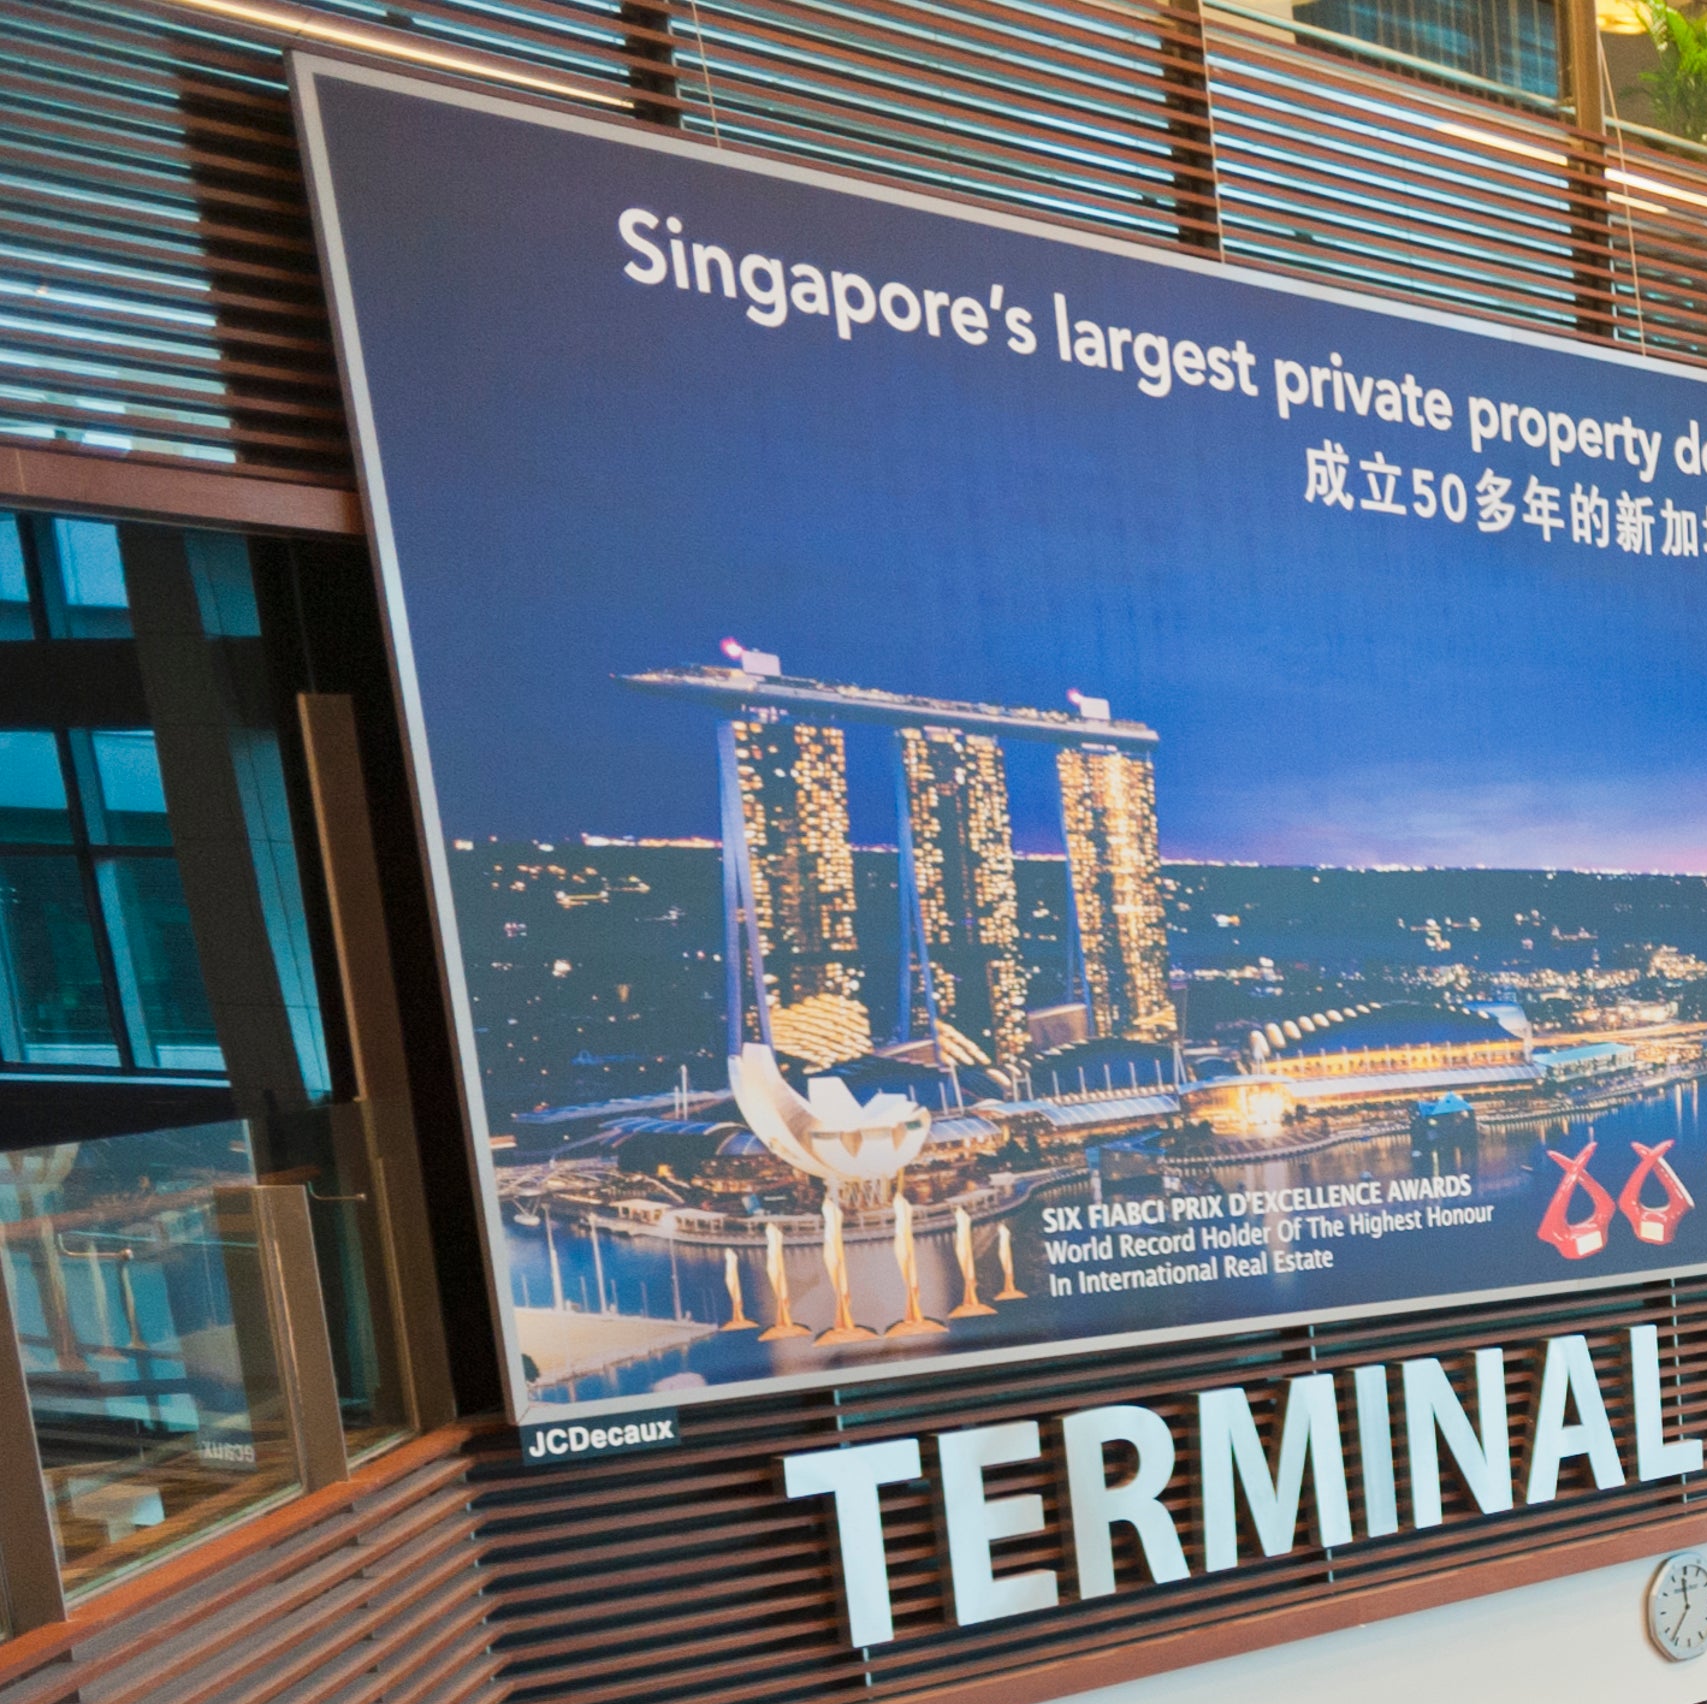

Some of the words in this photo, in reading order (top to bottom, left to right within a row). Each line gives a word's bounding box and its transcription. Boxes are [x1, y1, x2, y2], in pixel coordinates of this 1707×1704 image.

[617, 207, 1038, 358] Singapore's
[1055, 292, 1258, 399] largest
[1275, 353, 1453, 430] private
[1469, 396, 1662, 482] property
[1042, 1207, 1082, 1235] SIX
[1088, 1201, 1166, 1230] FIABCI
[1171, 1195, 1223, 1223] PRIX
[1229, 1180, 1382, 1218] D'EXCELLENCE
[1387, 1174, 1472, 1203] AWARDS
[1045, 1236, 1113, 1264] World
[1120, 1229, 1196, 1258] Record
[1202, 1222, 1270, 1251] Holder
[1278, 1217, 1302, 1244] Of
[1306, 1214, 1345, 1241] The
[1350, 1206, 1423, 1240] Highest
[1426, 1202, 1495, 1229] Honour
[1049, 1273, 1072, 1297] In
[1078, 1254, 1218, 1293] International
[1224, 1253, 1268, 1281] Real
[1273, 1248, 1334, 1276] Estate
[529, 1421, 674, 1459] JCDecaux
[785, 1326, 1704, 1648] TERMINAL
